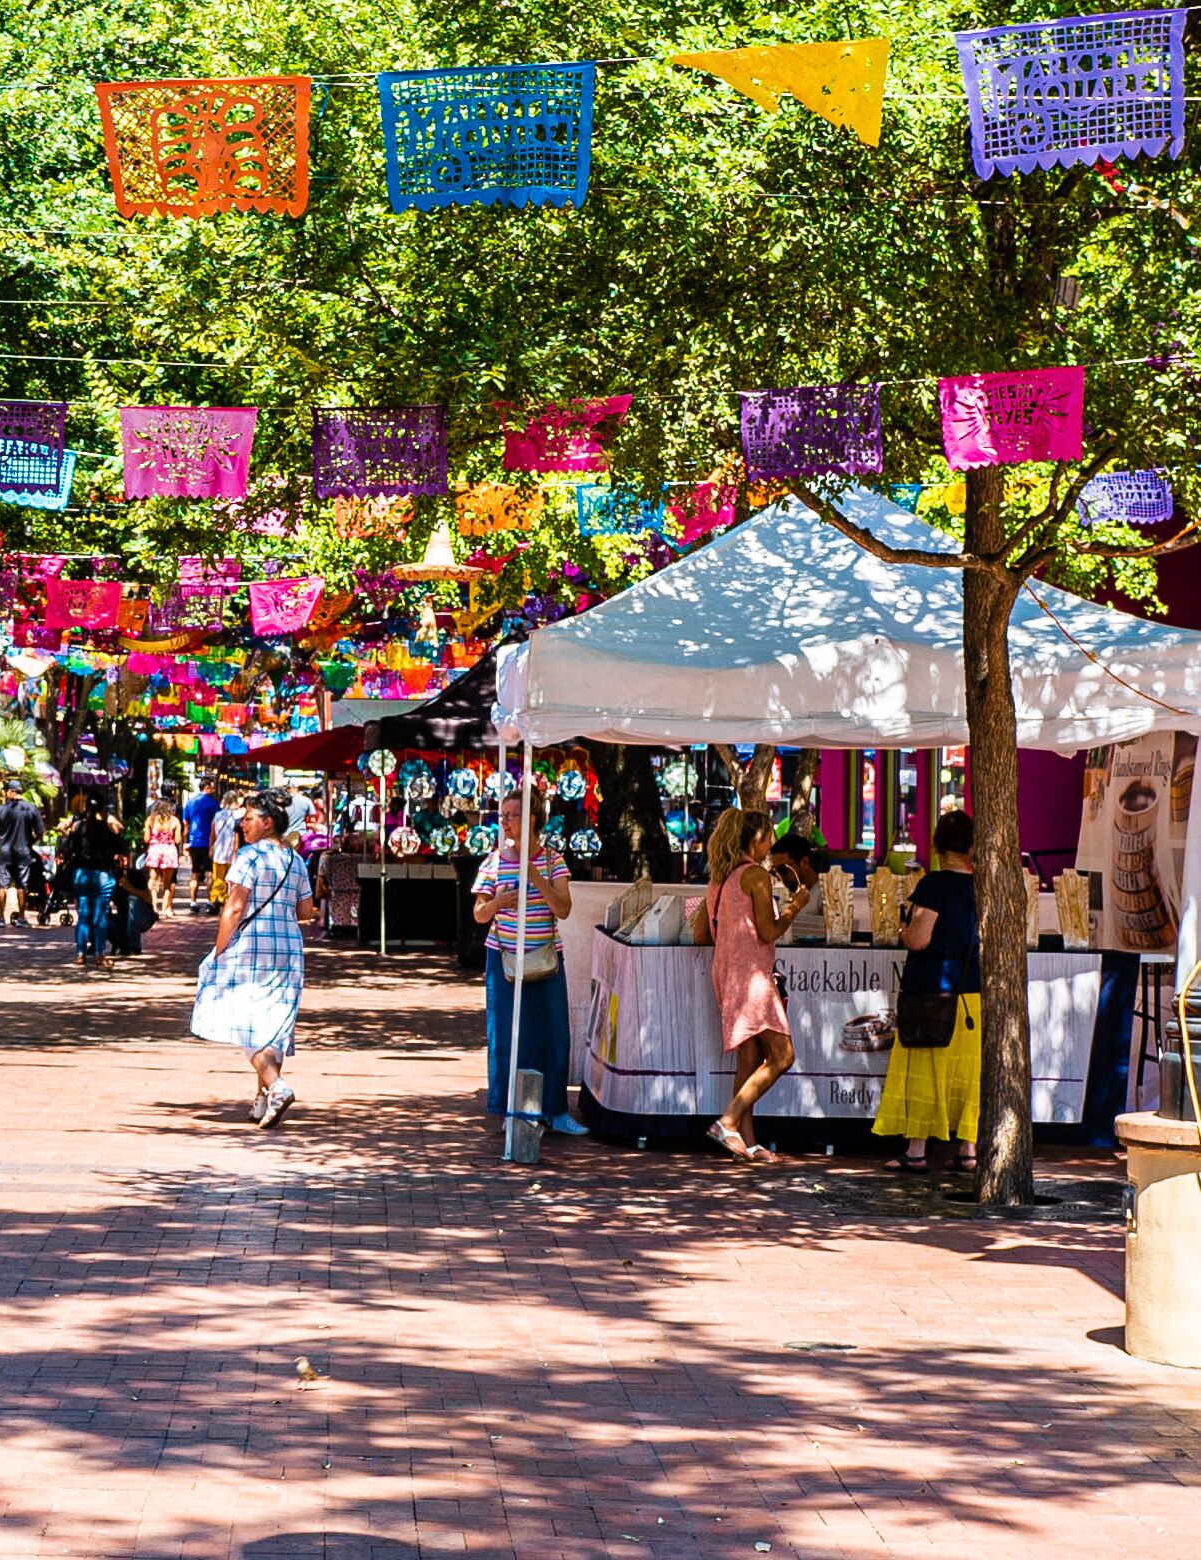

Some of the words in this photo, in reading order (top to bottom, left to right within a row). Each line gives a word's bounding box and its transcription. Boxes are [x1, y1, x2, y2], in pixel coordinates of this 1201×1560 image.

[975, 47, 1136, 115] MARKET
[1013, 68, 1165, 153] SQUARE
[407, 98, 545, 158] MARKET
[774, 958, 881, 993] Stackable
[829, 1080, 874, 1108] Ready
